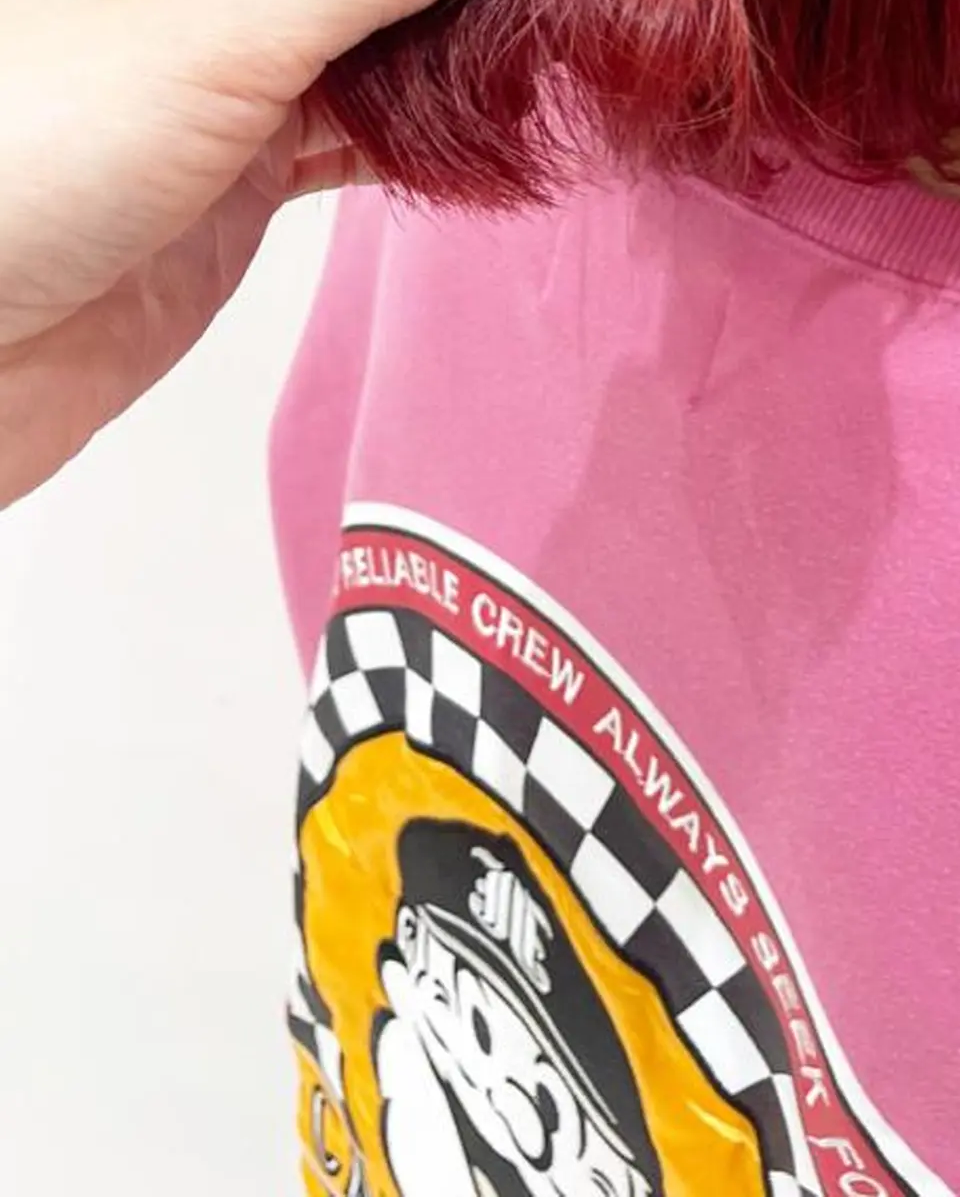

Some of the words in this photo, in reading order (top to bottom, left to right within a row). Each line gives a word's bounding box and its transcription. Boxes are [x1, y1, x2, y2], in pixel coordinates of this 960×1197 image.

[340, 545, 460, 615] RELIABLE
[471, 592, 583, 706] CREW
[592, 706, 749, 917] ALWAYS
[751, 932, 831, 1107] SEEK
